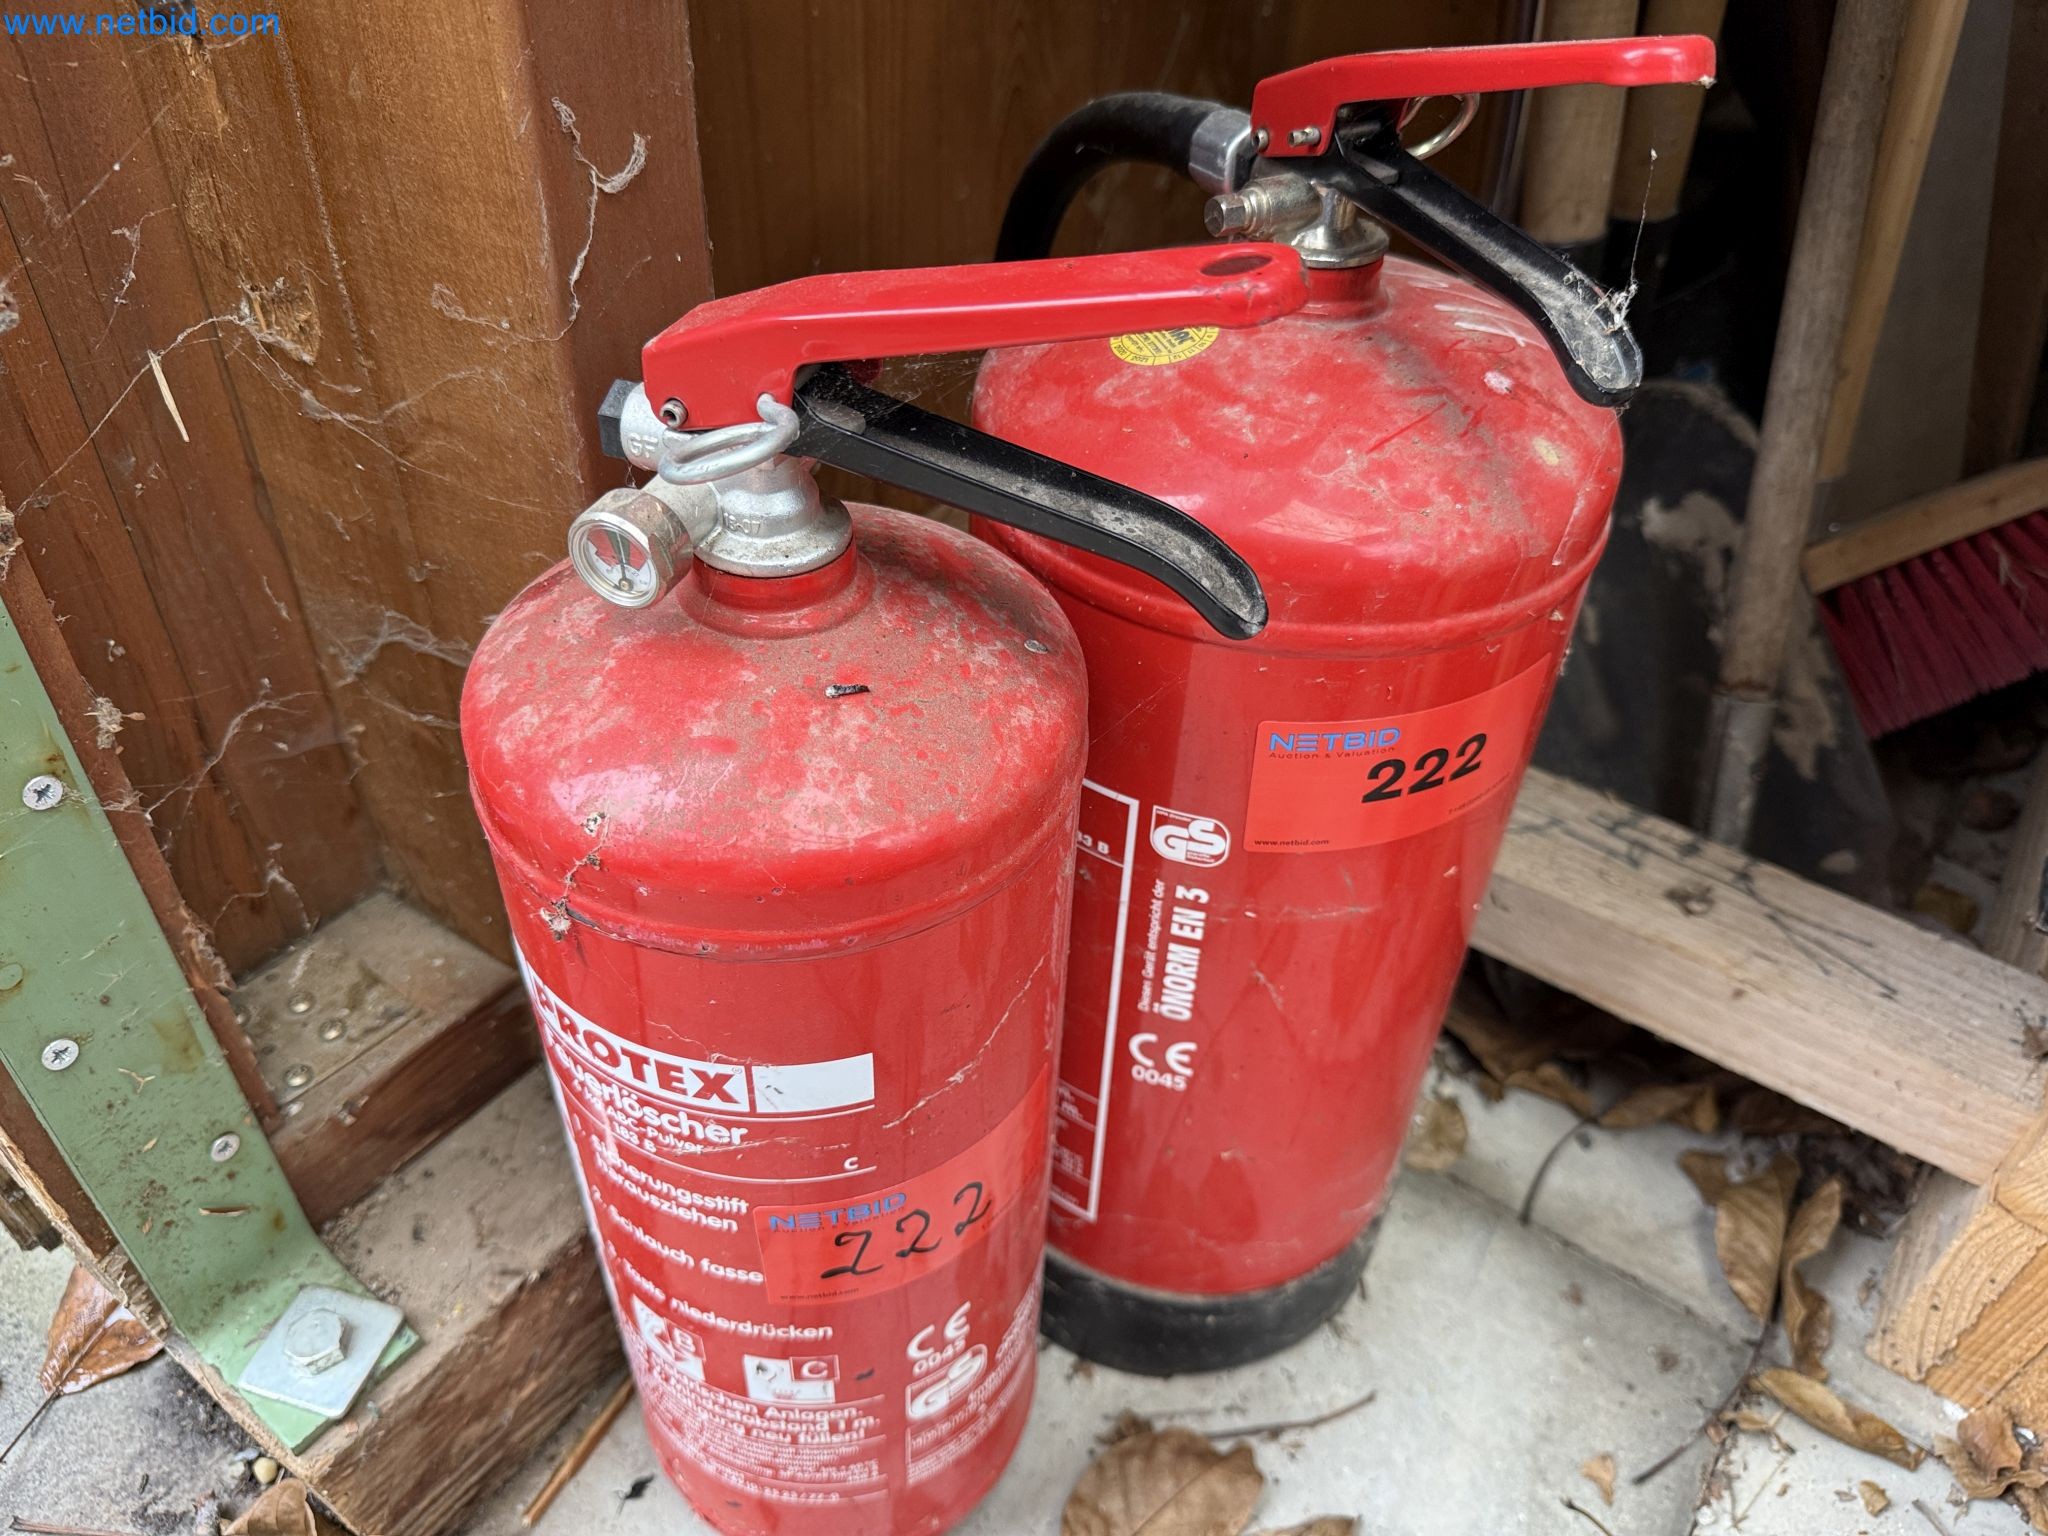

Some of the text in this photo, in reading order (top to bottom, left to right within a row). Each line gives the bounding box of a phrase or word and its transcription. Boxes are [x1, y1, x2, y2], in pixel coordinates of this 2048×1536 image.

[1269, 727, 1401, 752] NETBID
[1269, 752, 1319, 760] Auction
[1336, 746, 1396, 759] Valuation
[1361, 733, 1488, 804] 222
[1153, 818, 1226, 862] GS
[1254, 838, 1330, 847] www.netbid.com
[1154, 879, 1166, 898] der
[1175, 885, 1209, 904] 3
[1148, 899, 1163, 951] entspricht
[1170, 906, 1207, 940] EN
[1142, 951, 1158, 980] Gerät
[1152, 942, 1201, 1021] ÖNORM
[1132, 1064, 1187, 1091] 0045
[606, 1104, 703, 1154] ABC-Pulver
[643, 1138, 657, 1153] B
[843, 1156, 859, 1170] C
[595, 1151, 738, 1233] herausziehen
[769, 1192, 907, 1231] NETBID
[608, 1204, 695, 1268] Schlauch
[700, 1257, 763, 1285] fasse
[820, 1181, 991, 1279] 222
[670, 1297, 834, 1341] niederdrücken
[672, 1326, 697, 1353] B
[913, 1335, 966, 1376] 0045
[800, 1359, 829, 1380] C
